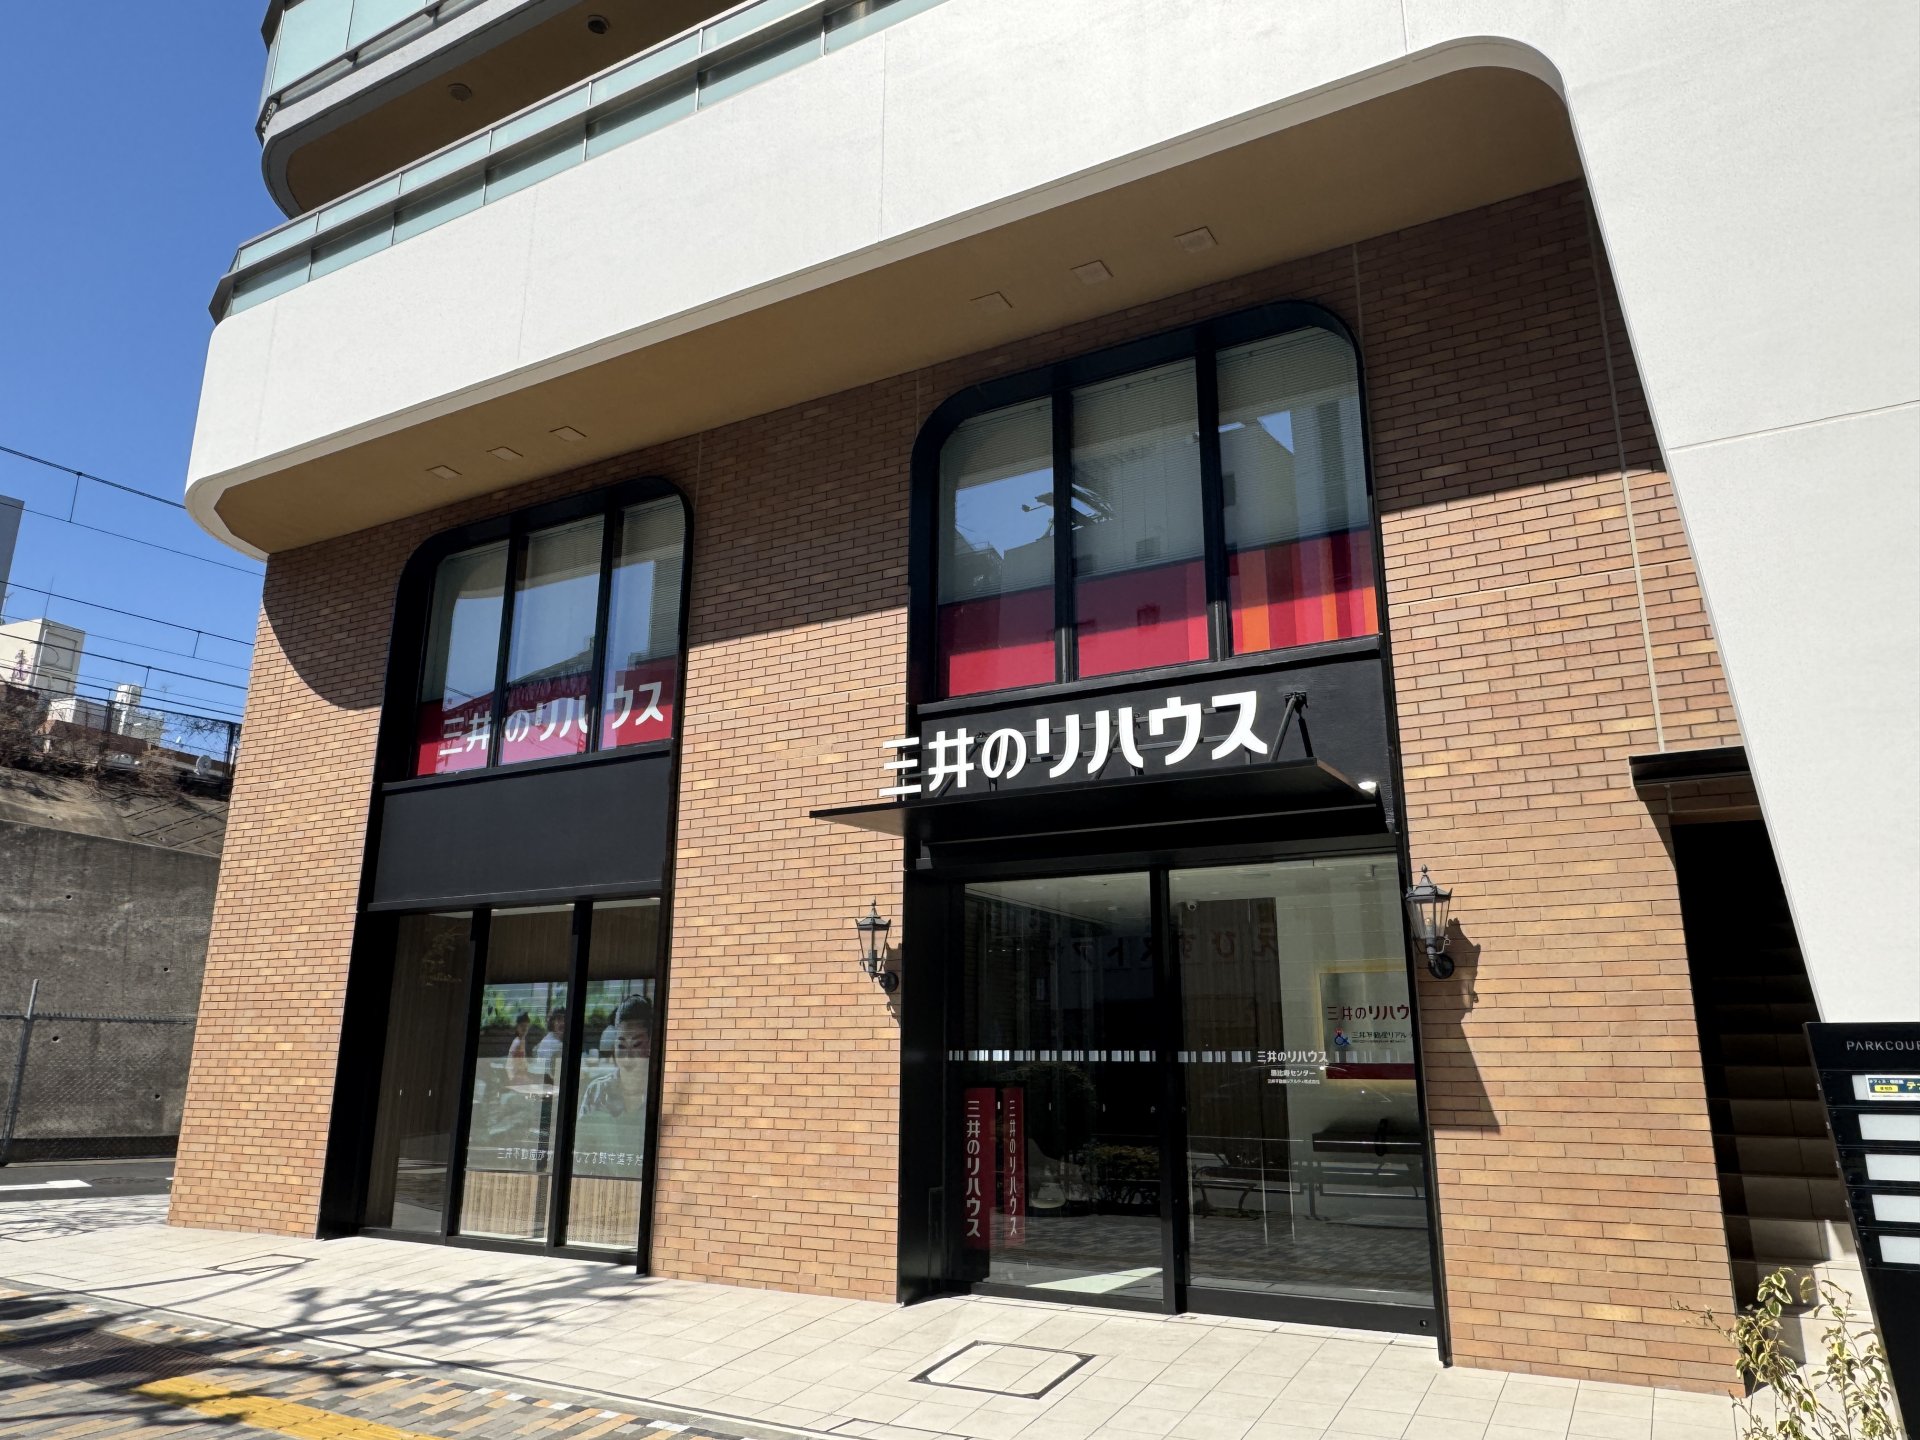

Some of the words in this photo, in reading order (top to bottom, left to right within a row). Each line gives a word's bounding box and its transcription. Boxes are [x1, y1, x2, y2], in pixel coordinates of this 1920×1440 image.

[439, 681, 664, 756] 三井のリハウス
[878, 690, 1268, 797] 三井のリハウス
[1257, 1050, 1329, 1063] 三井のリハウス
[966, 1100, 981, 1238] 三井のリハウス
[1009, 1100, 1017, 1237] 三井のリハウス
